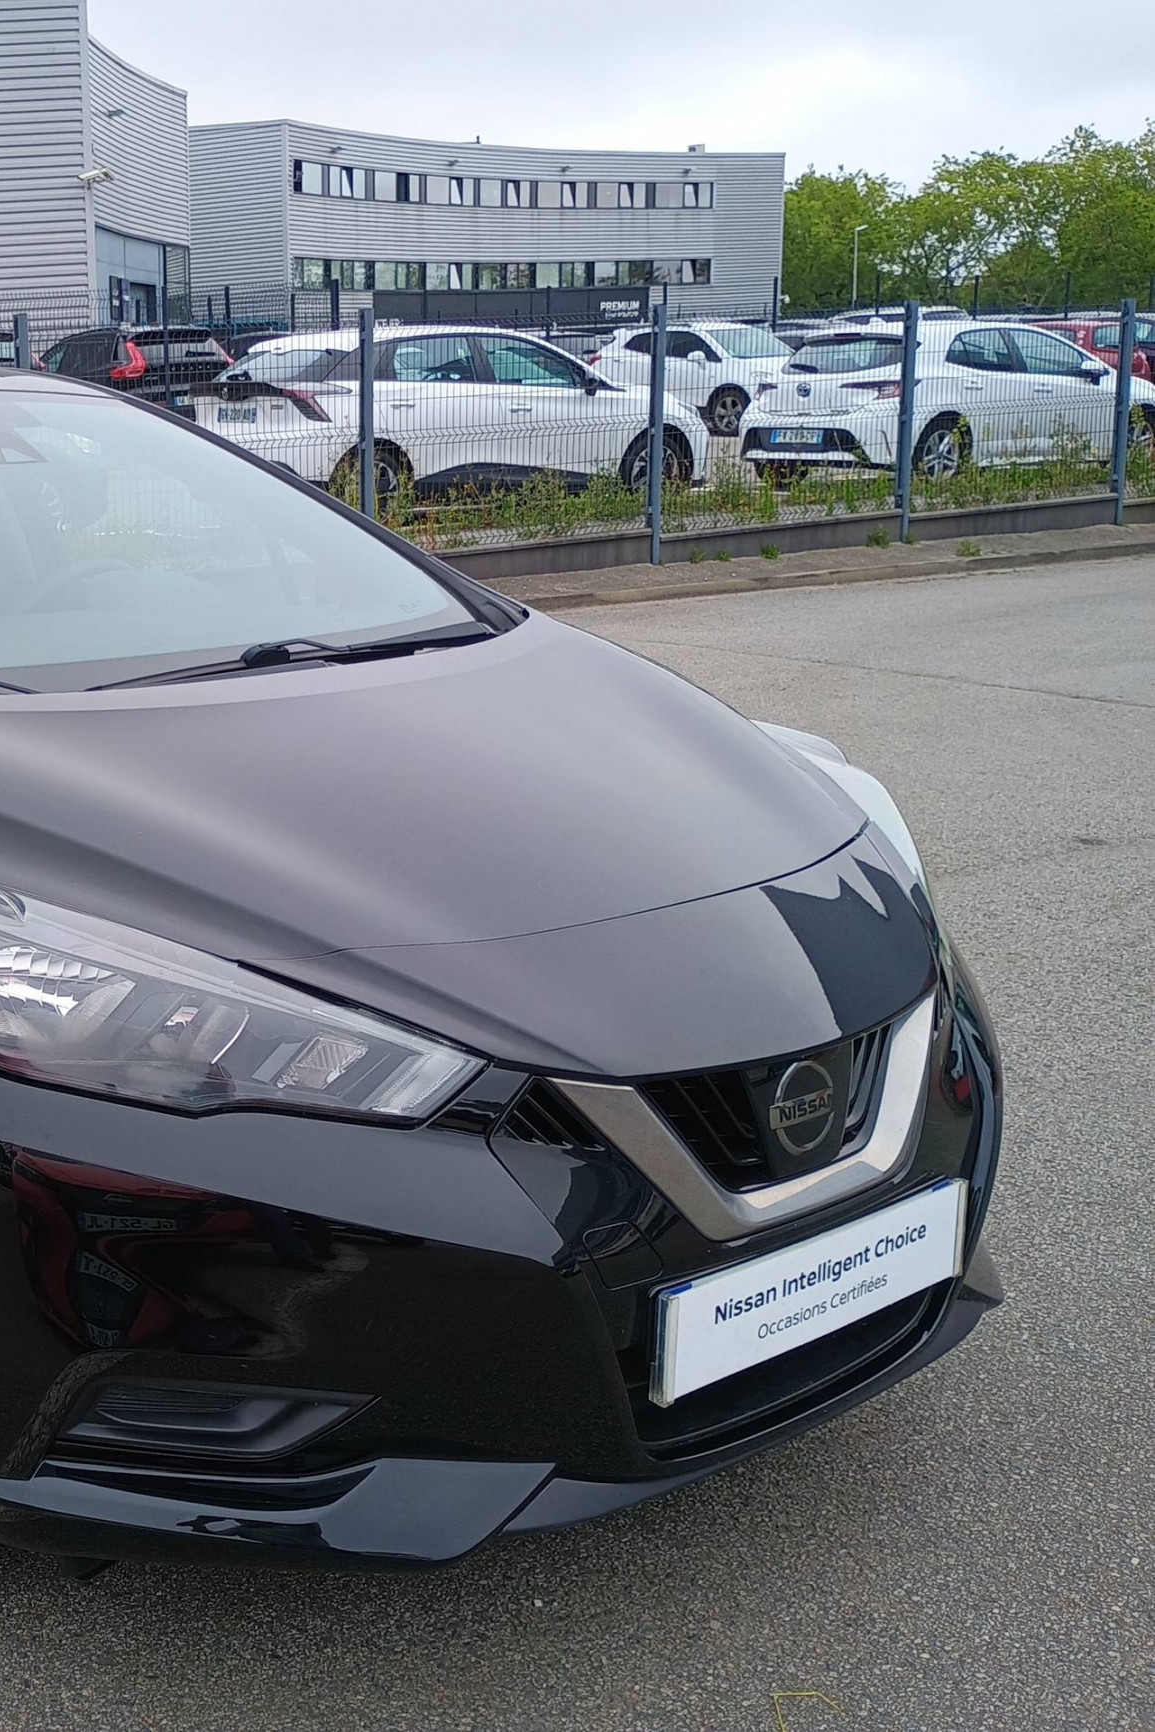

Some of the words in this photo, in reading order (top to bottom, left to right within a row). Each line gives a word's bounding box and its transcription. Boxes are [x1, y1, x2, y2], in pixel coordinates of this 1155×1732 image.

[600, 300, 640, 311] PREMIUM
[714, 1286, 777, 1325] Nissan
[782, 1246, 871, 1298] Intelligent
[874, 1223, 927, 1258] Choice
[757, 1299, 827, 1339] Occasions
[830, 1273, 888, 1309] Certifiées
